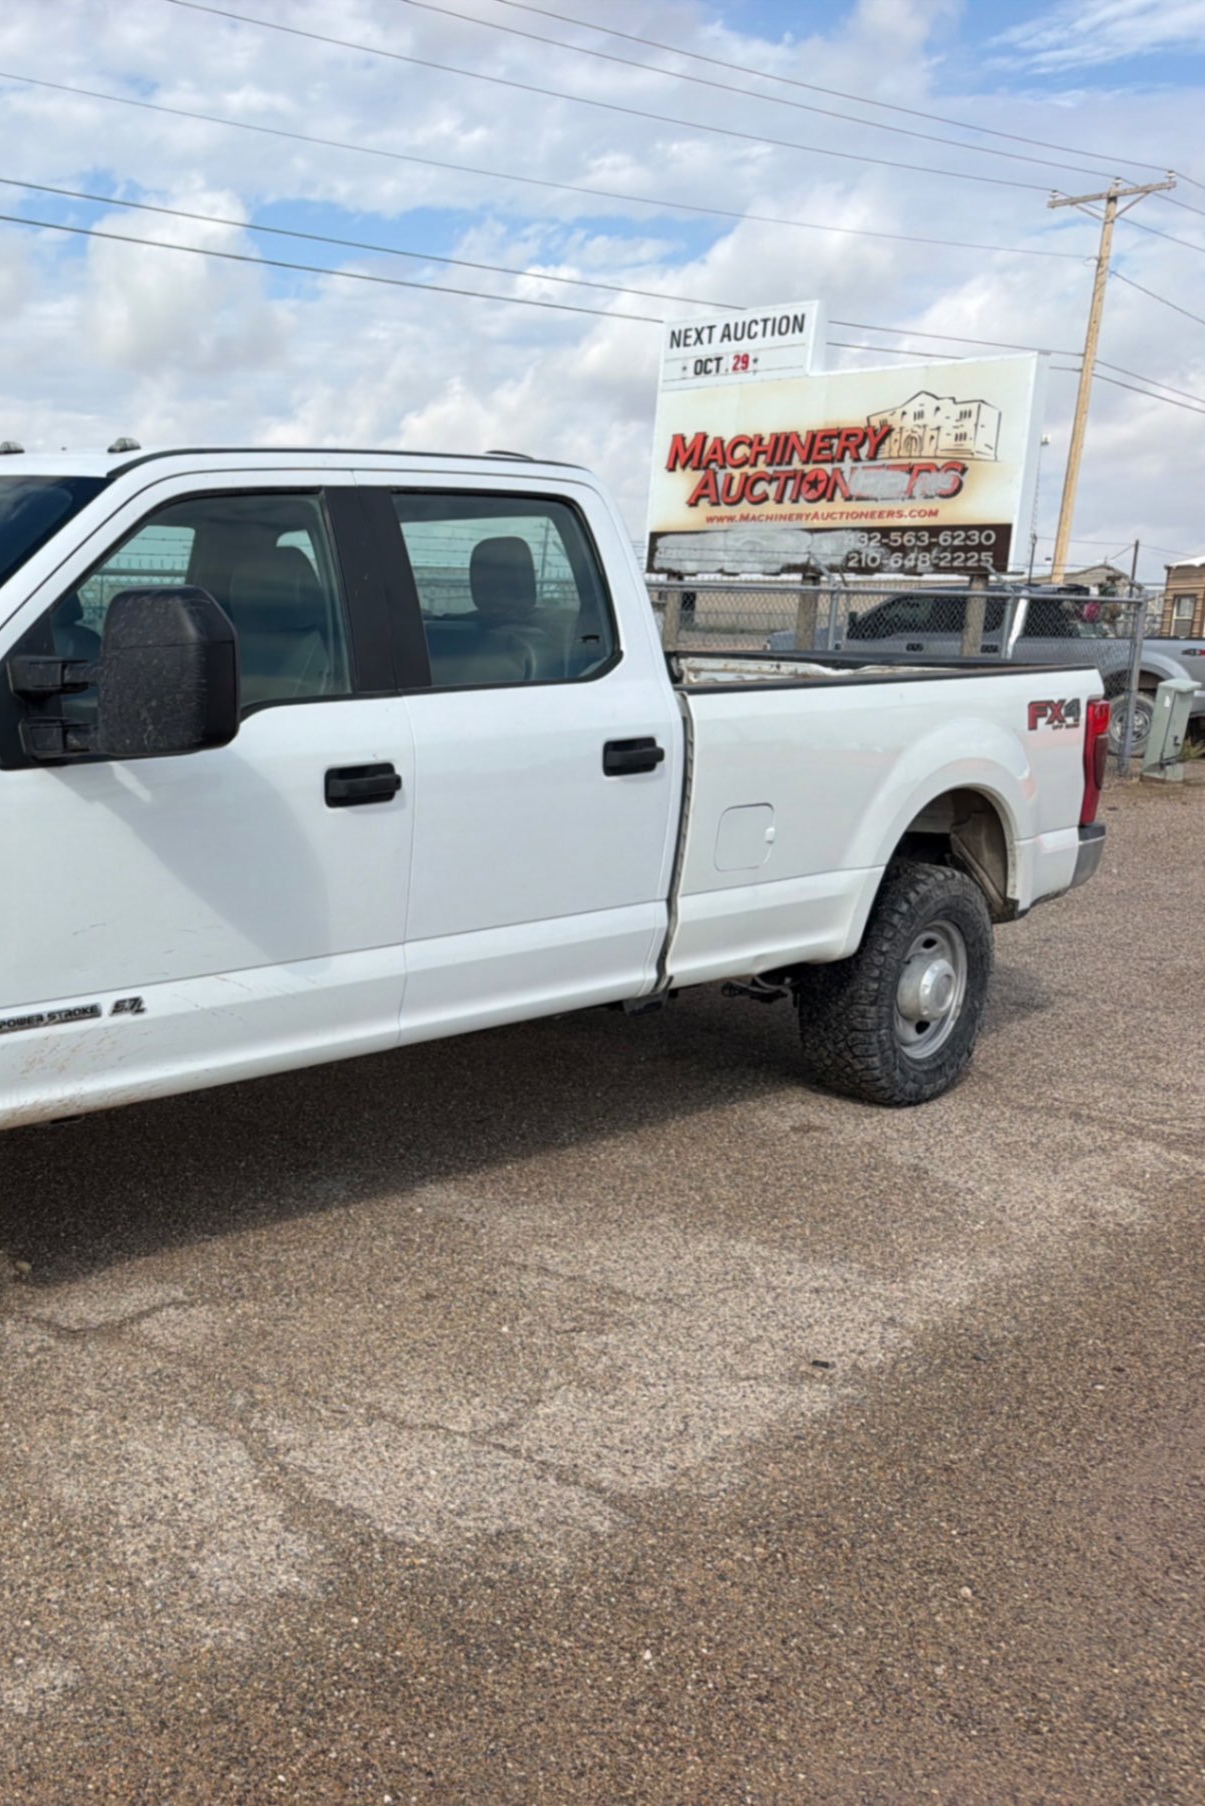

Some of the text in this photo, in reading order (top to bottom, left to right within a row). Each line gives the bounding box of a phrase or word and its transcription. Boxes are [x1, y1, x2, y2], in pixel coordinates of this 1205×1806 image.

[669, 313, 805, 349] NEXT AUCTION
[732, 353, 750, 371] 29
[666, 425, 892, 471] MACHINERY
[845, 530, 996, 547] 32-563-6230
[1027, 698, 1081, 731] FX4
[47, 1004, 99, 1019] STROKE
